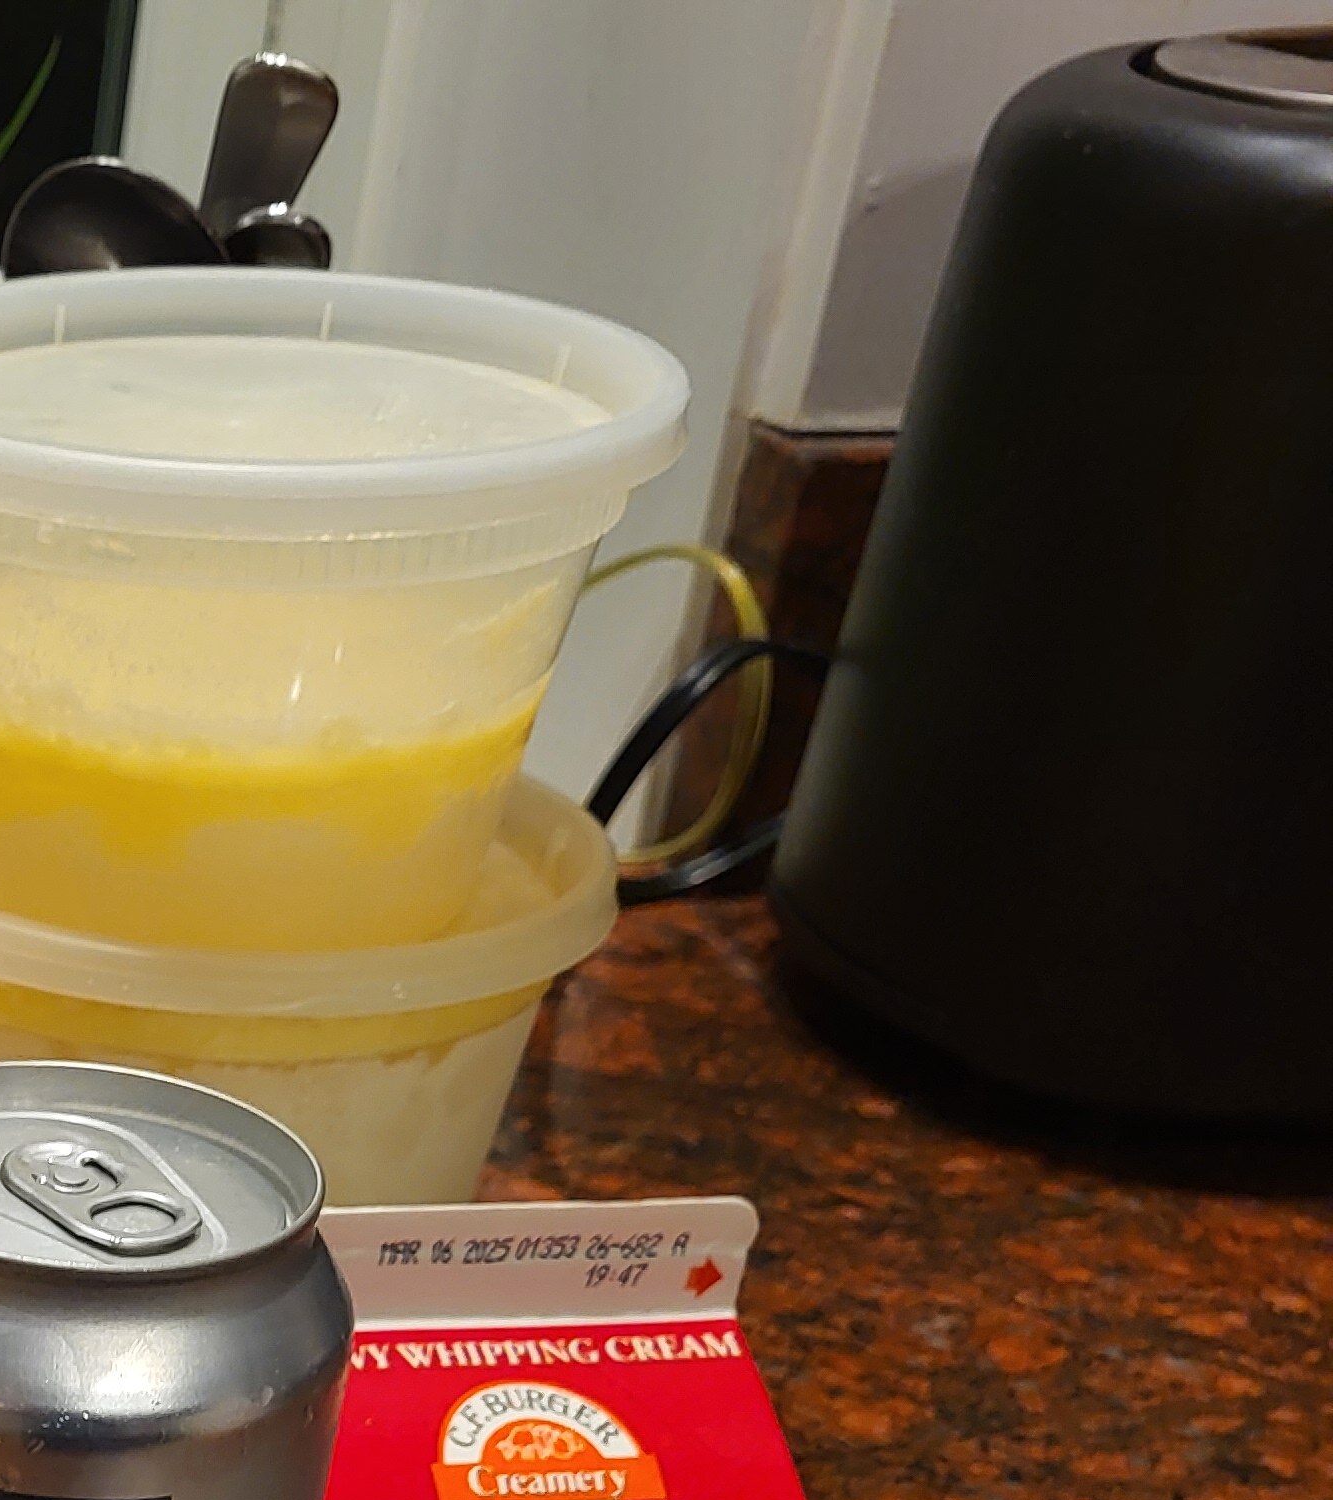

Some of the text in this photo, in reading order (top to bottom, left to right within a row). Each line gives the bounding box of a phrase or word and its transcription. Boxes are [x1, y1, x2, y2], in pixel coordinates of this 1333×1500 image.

[462, 1237, 514, 1264] 2025
[395, 1339, 600, 1371] WHIPPING
[604, 1331, 742, 1362] CREAM
[467, 1462, 628, 1498] Creamery
